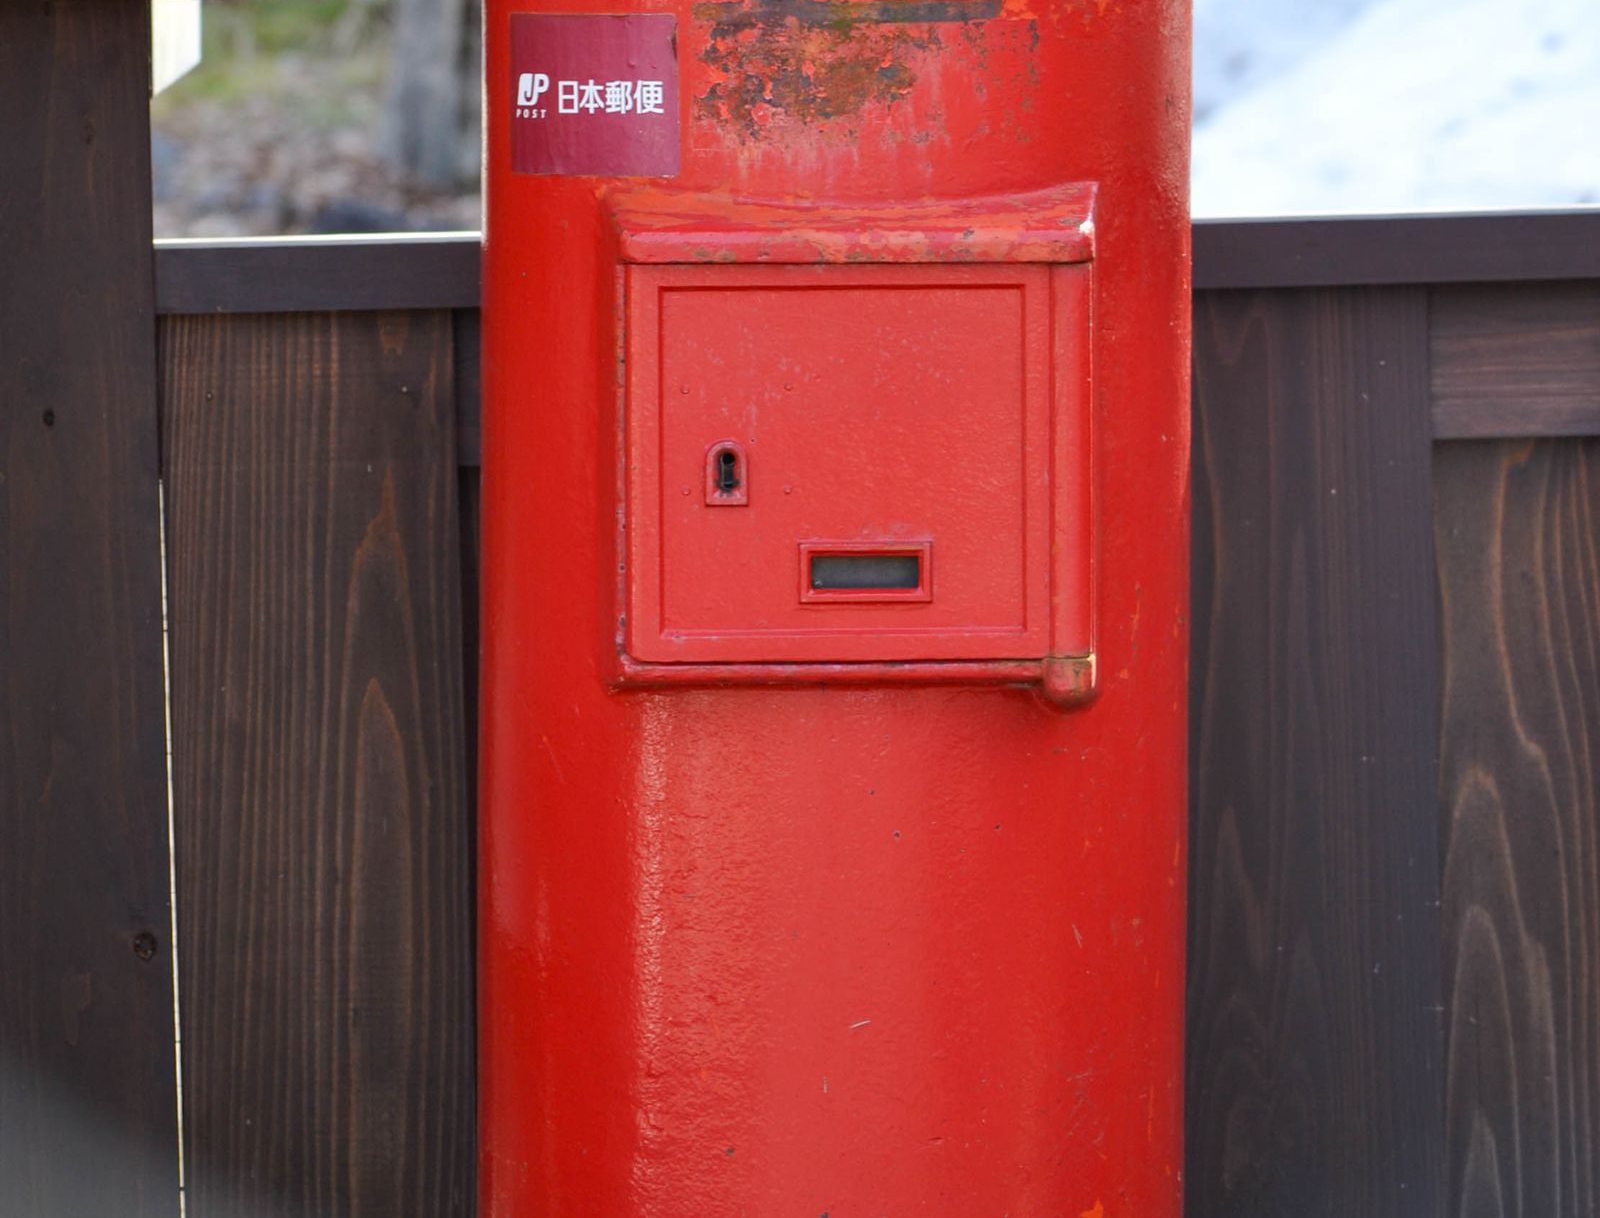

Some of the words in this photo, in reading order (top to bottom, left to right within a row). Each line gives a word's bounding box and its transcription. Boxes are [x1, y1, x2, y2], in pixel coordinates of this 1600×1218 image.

[558, 79, 665, 114] 日本郵便
[516, 109, 547, 118] POST
